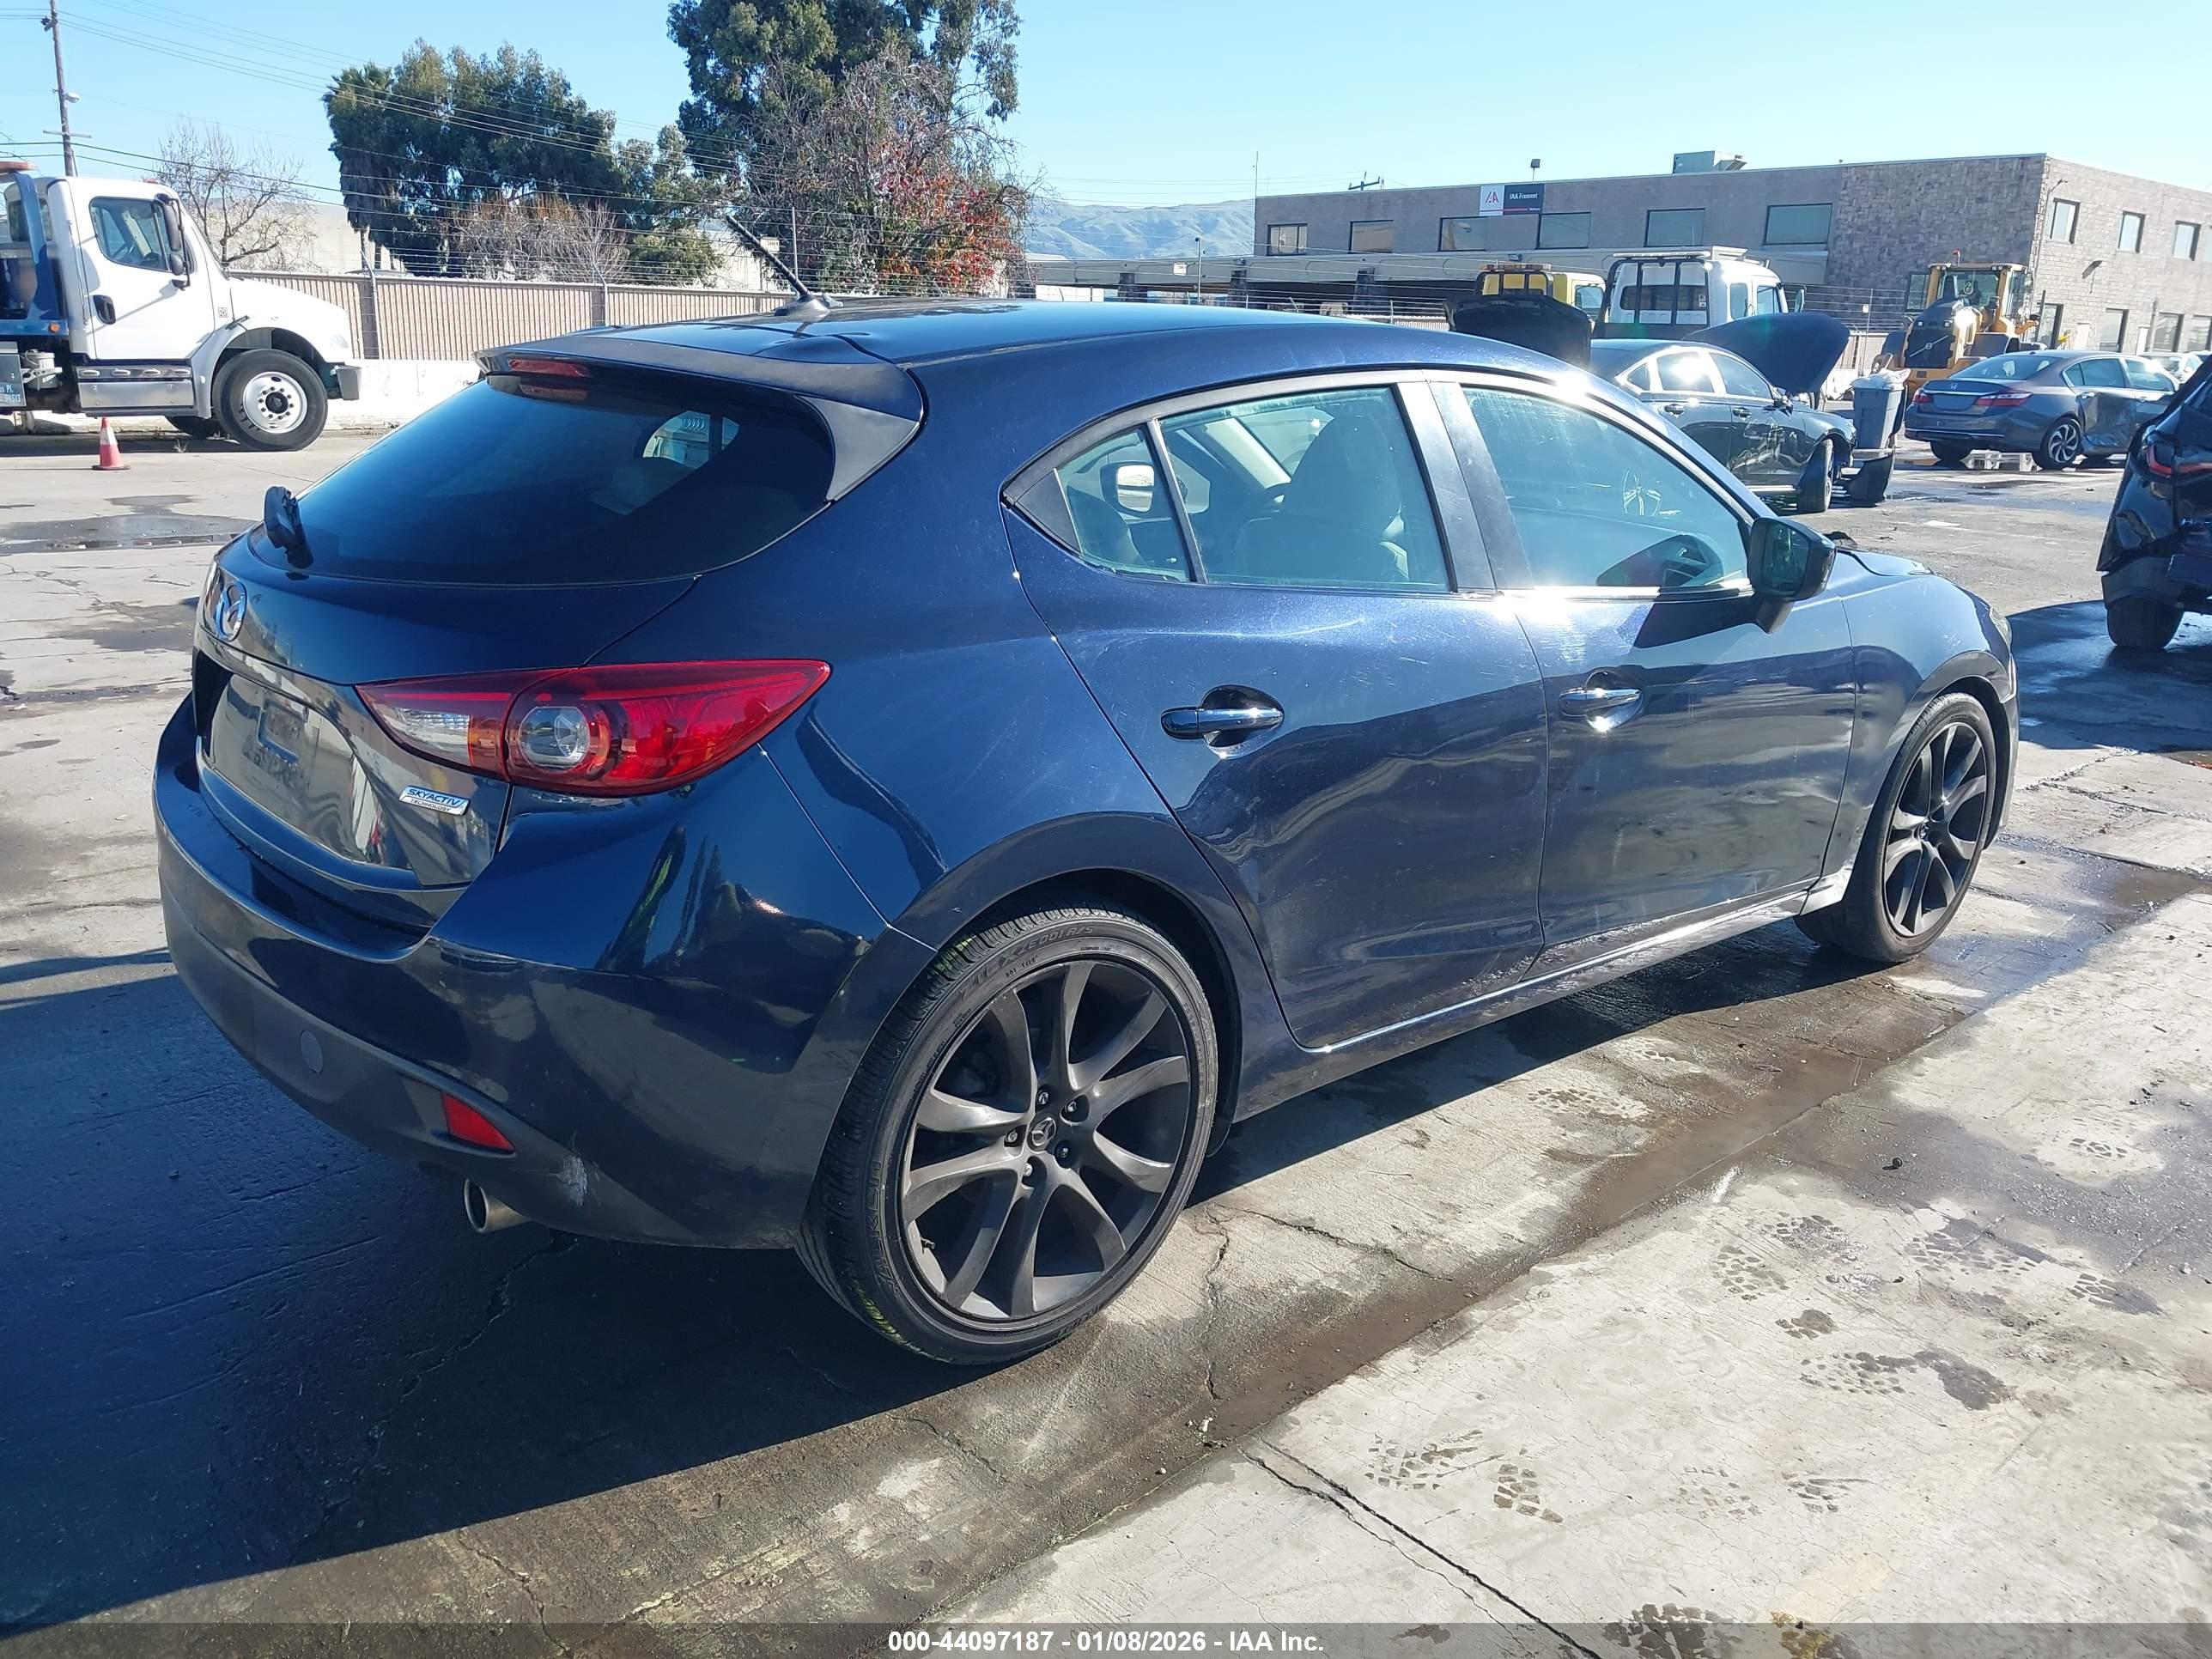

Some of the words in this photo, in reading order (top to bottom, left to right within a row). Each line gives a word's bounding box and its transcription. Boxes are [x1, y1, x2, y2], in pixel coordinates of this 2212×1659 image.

[407, 788, 460, 805] SKYACTIV
[410, 799, 452, 811] TECHNOLOGY
[1066, 925, 1095, 939] A/S
